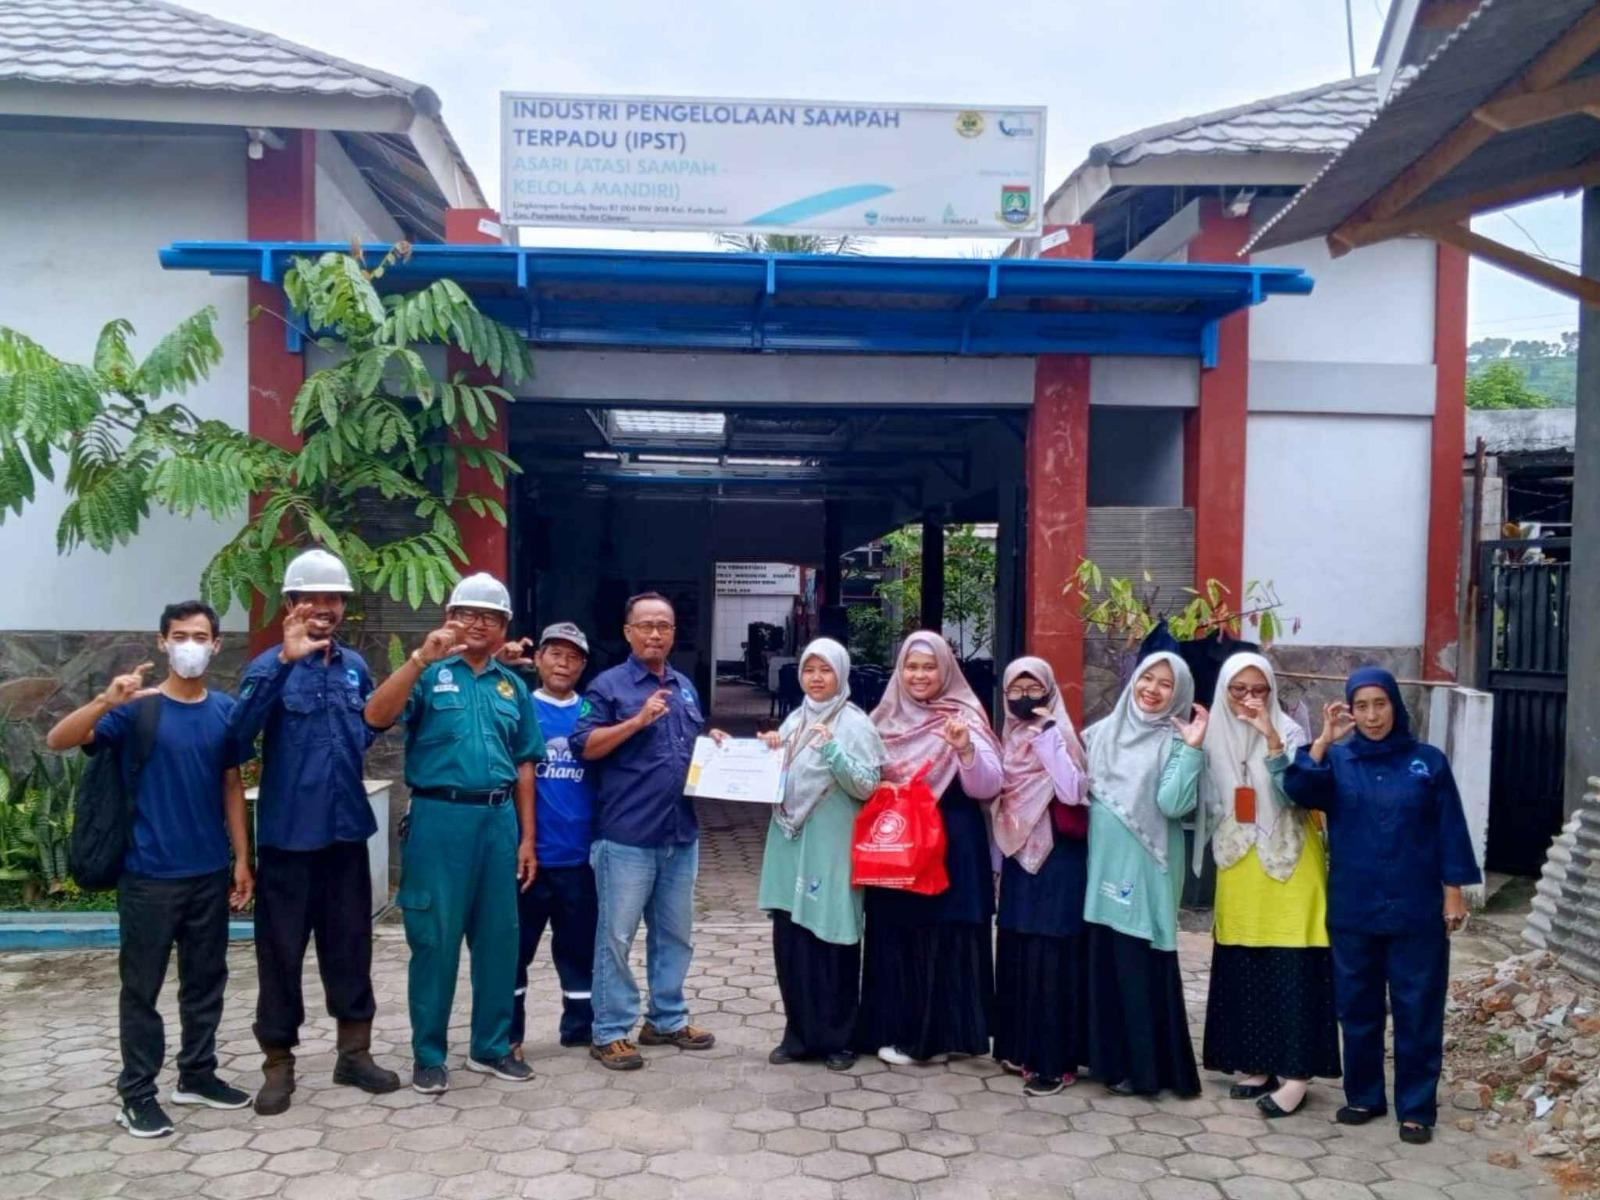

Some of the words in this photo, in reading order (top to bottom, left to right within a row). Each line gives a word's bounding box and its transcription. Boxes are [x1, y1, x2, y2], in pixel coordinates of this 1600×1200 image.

[513, 101, 618, 120] INDUSTRI
[626, 104, 795, 125] PENGELOLAAN
[803, 108, 899, 128] SAMPAH
[513, 129, 617, 148] TERPADU
[624, 131, 686, 154] (IPST)
[512, 156, 568, 171] ASARI
[574, 157, 630, 174] (ATASI
[636, 159, 716, 176] SAMPAH
[512, 179, 586, 195] KELOLA
[590, 181, 680, 201] MANDIRI)
[535, 762, 585, 783] Chang
